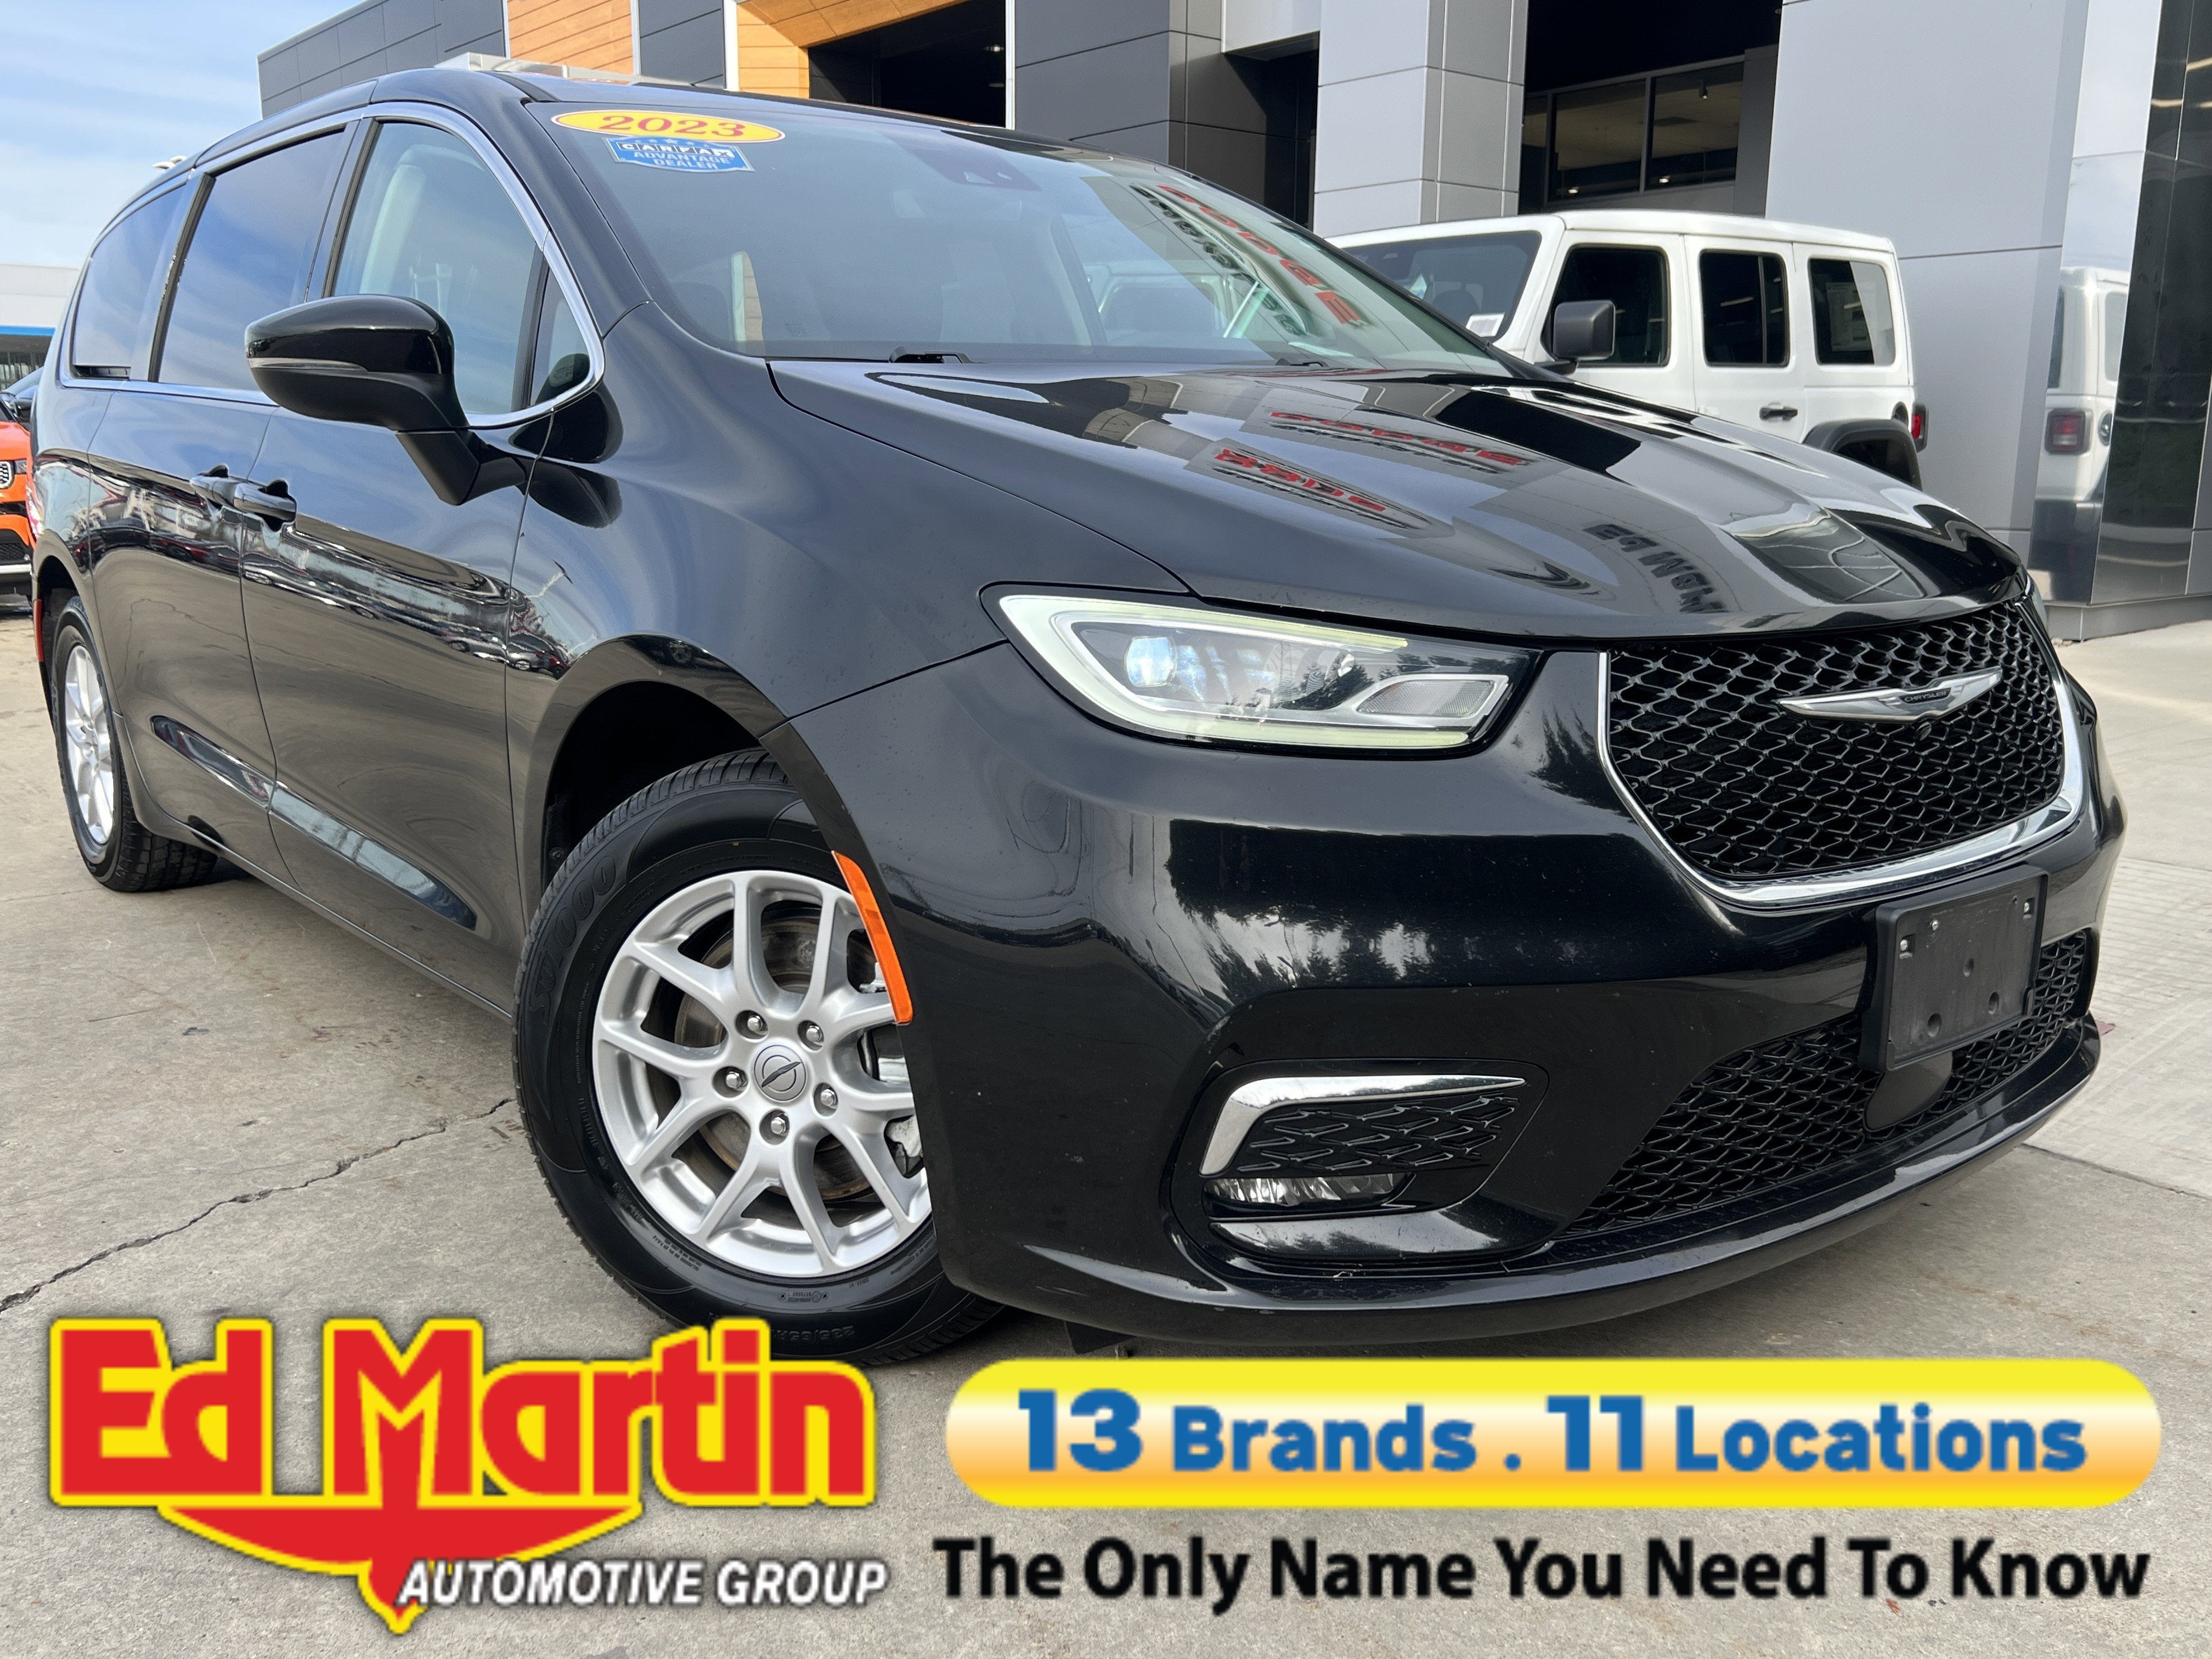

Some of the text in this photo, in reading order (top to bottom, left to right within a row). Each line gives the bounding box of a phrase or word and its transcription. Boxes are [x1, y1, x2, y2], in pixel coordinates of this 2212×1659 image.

[599, 116, 746, 137] 2023
[622, 143, 735, 158] CARFAX
[634, 151, 731, 164] ADVANTAGE
[654, 158, 718, 169] DEALER
[1904, 691, 1947, 702] CHRYSLER
